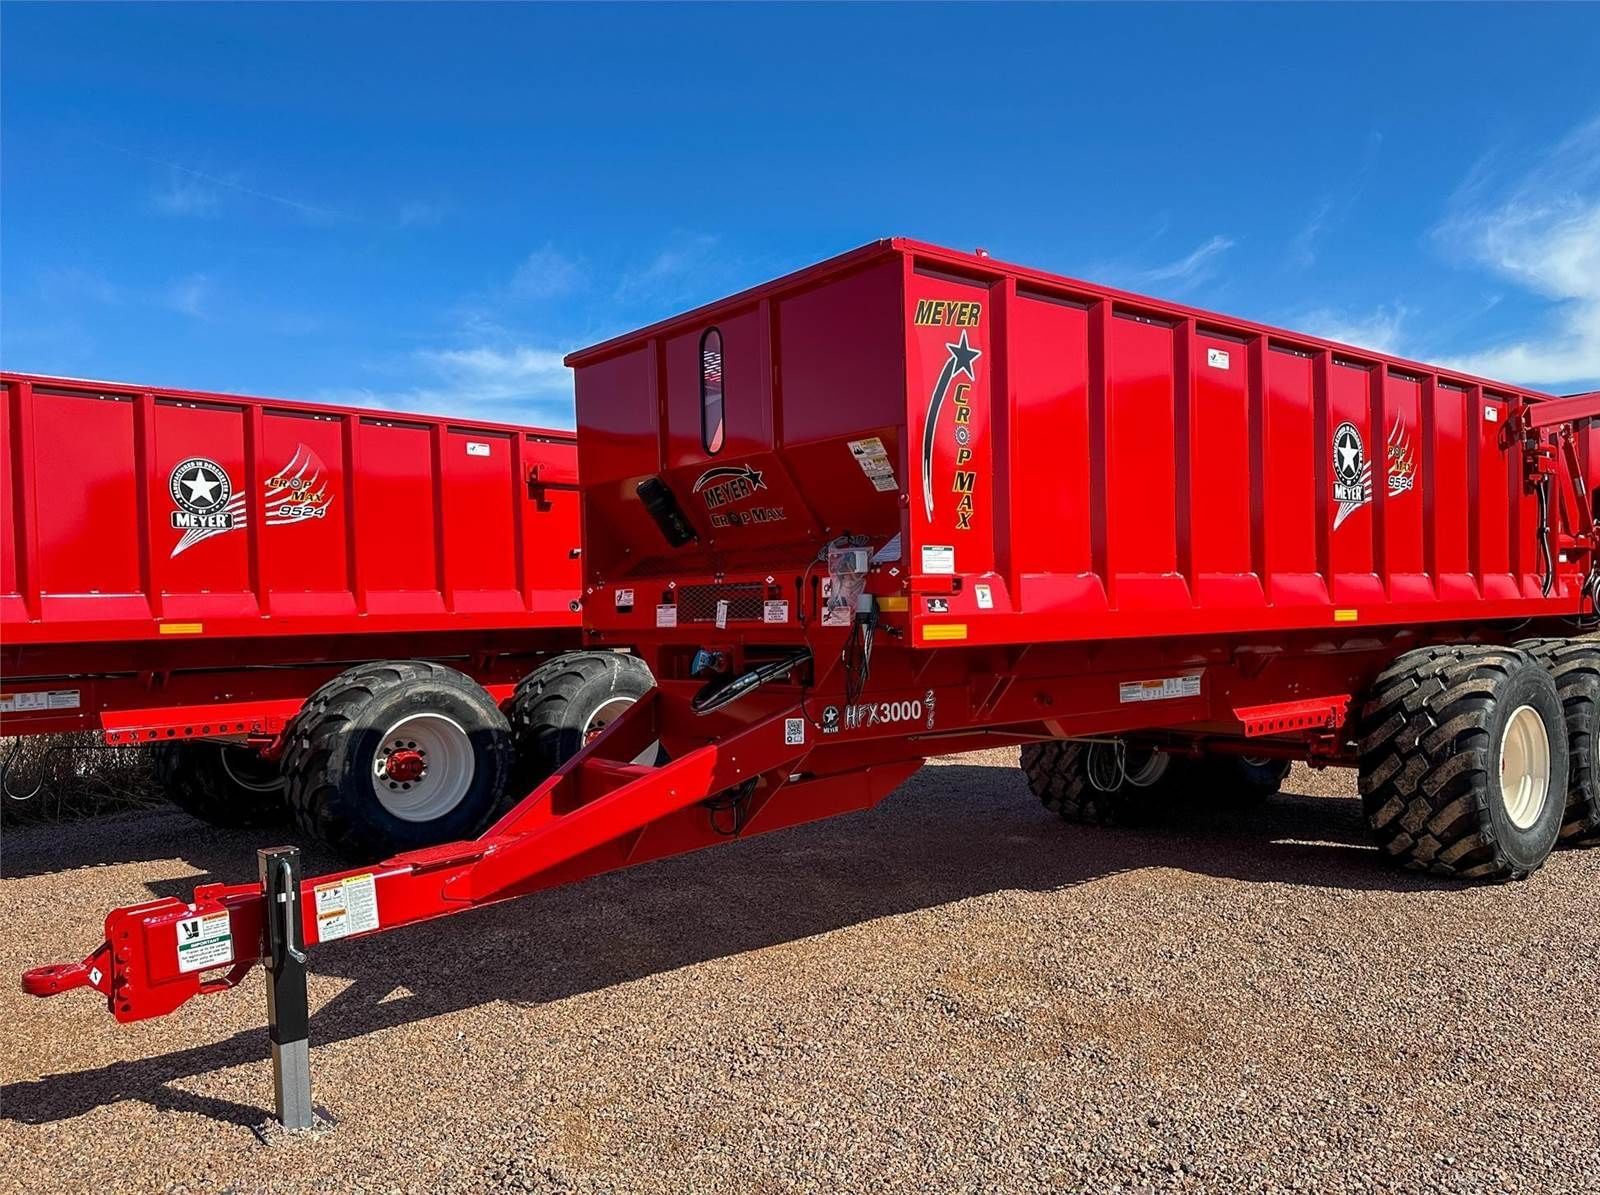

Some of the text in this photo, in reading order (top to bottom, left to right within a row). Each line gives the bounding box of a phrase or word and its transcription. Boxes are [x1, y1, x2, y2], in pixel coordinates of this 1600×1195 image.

[914, 299, 982, 327] MEYER
[1388, 475, 1414, 491] 9524
[291, 491, 324, 502] MAX
[702, 477, 752, 511] MEYER
[952, 471, 977, 530] MAX
[1334, 484, 1363, 501] MEYER
[279, 504, 326, 518] 9524
[750, 506, 787, 524] MAX
[176, 513, 227, 528] MEYER
